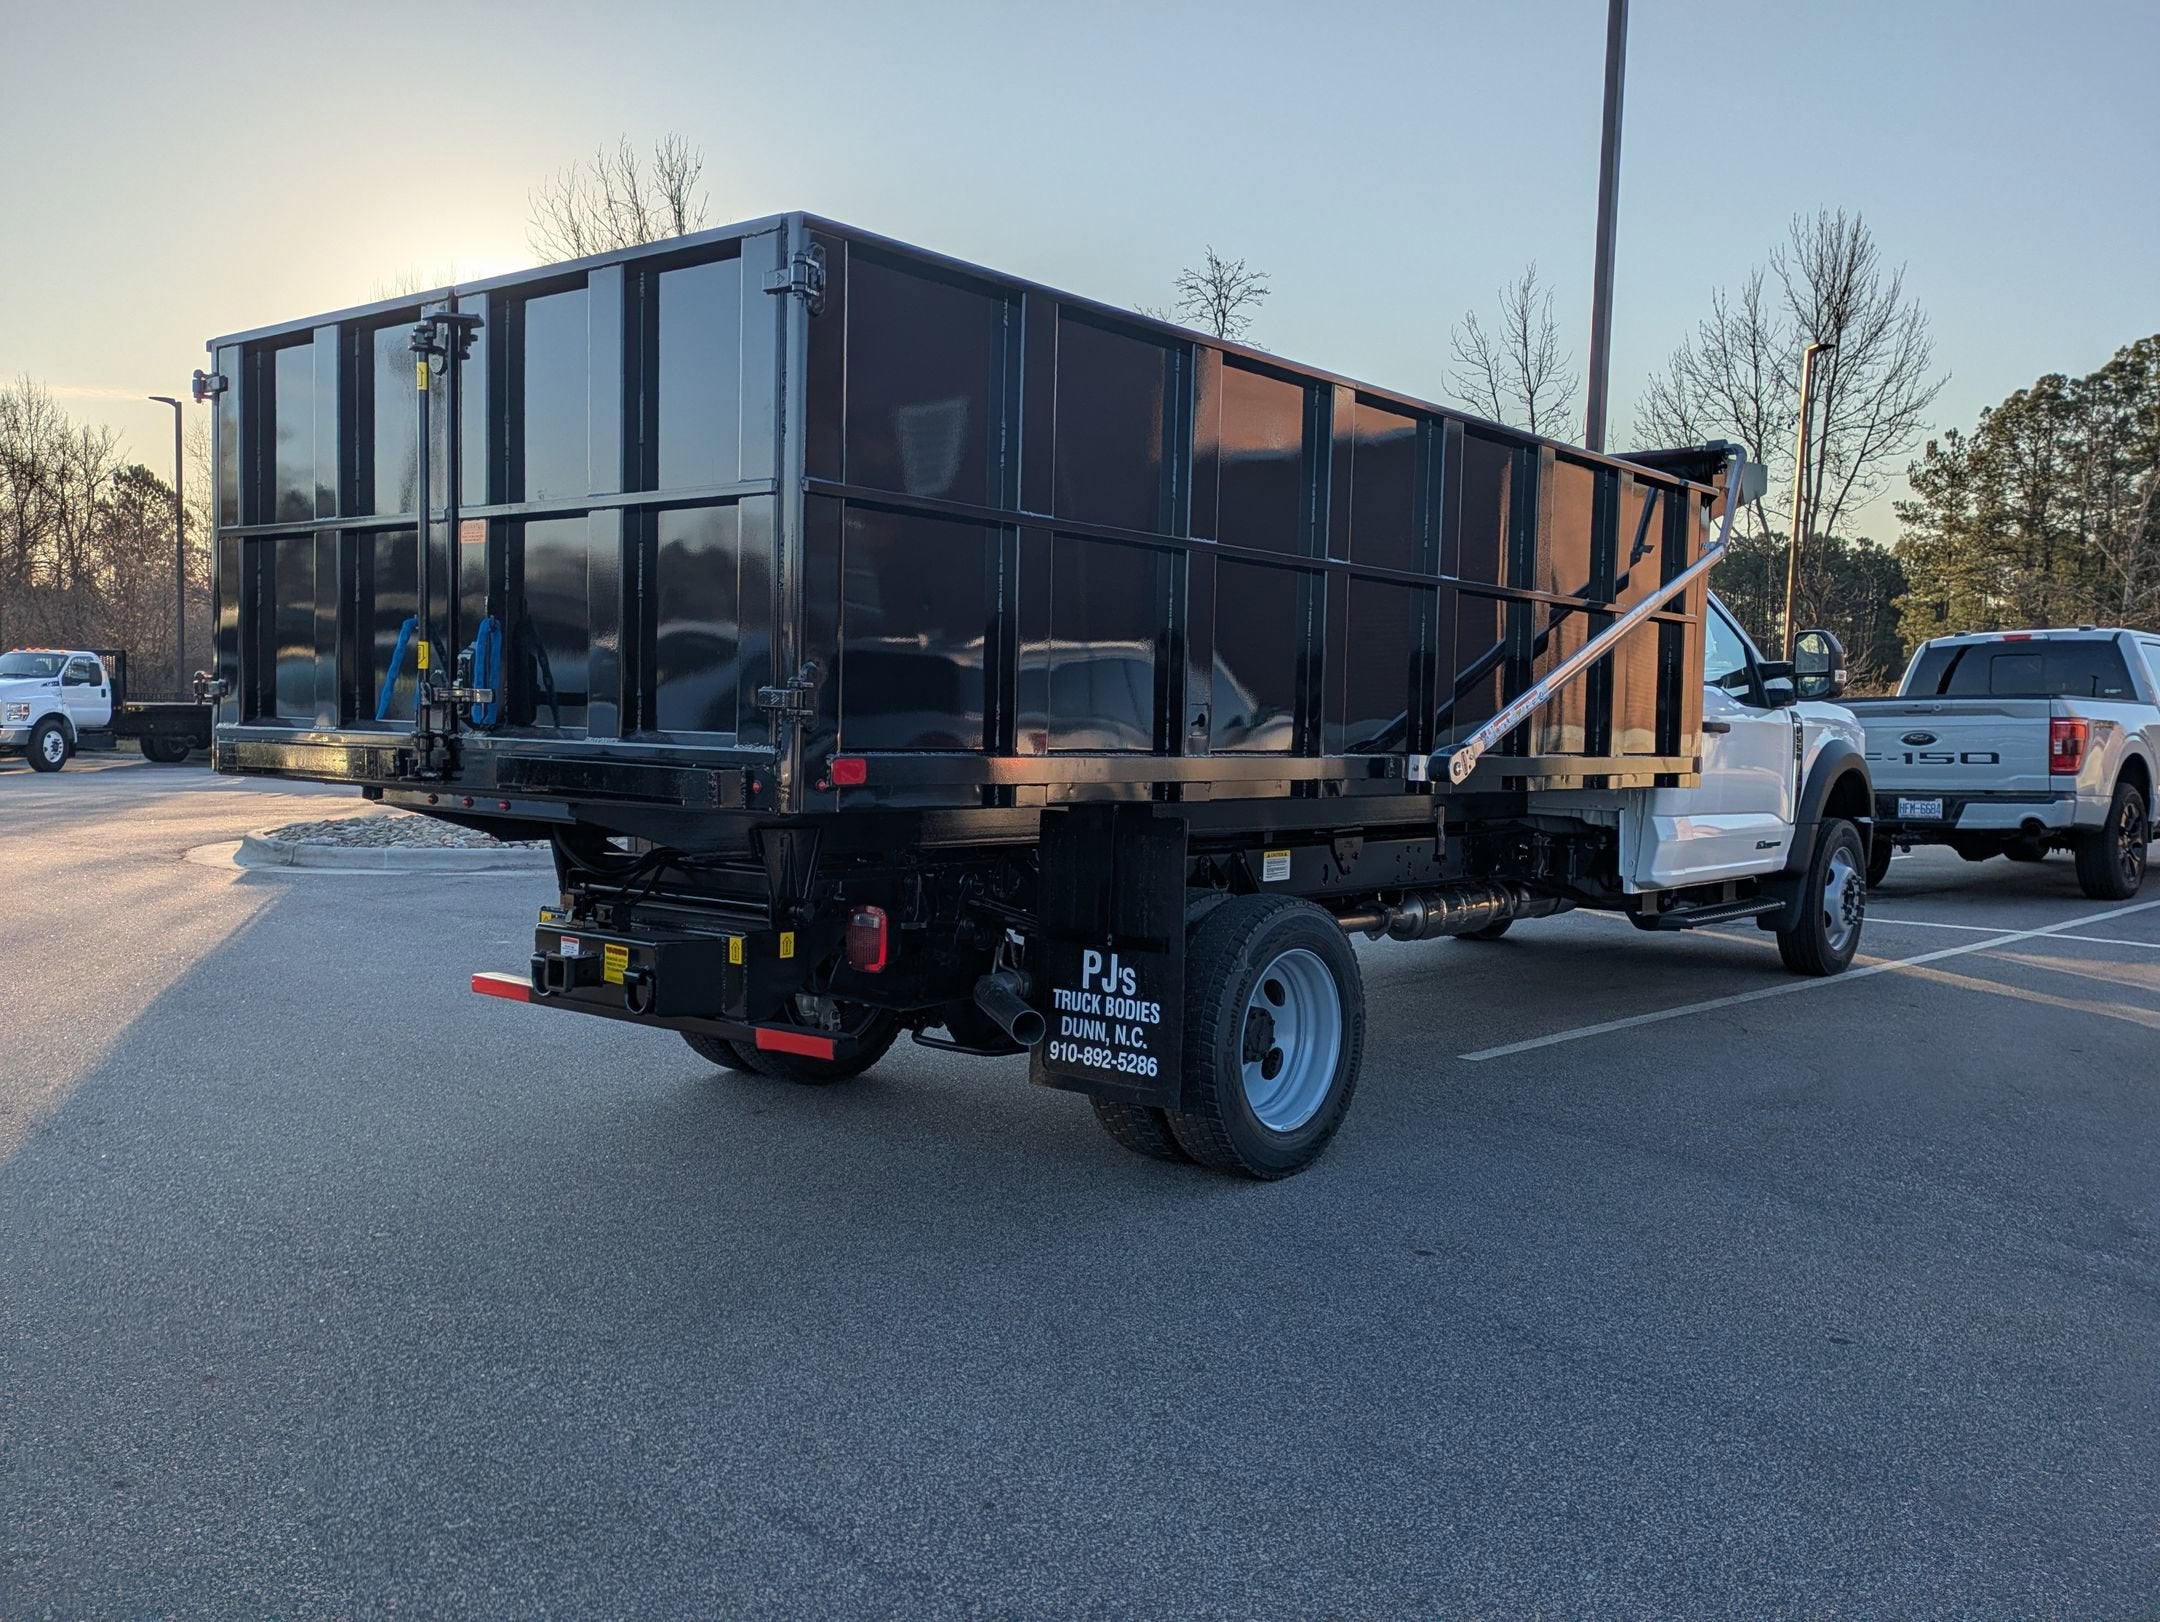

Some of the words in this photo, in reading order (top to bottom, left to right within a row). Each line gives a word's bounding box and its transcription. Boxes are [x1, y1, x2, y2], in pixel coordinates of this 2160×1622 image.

[1082, 949, 1137, 996] PJ's
[1052, 988, 1102, 1015] TRUCK
[1105, 996, 1161, 1024] BODIES
[1061, 1016, 1110, 1047] DUNN,
[1115, 1024, 1148, 1049] N.C.
[1049, 1040, 1158, 1077] 910-892-5286
